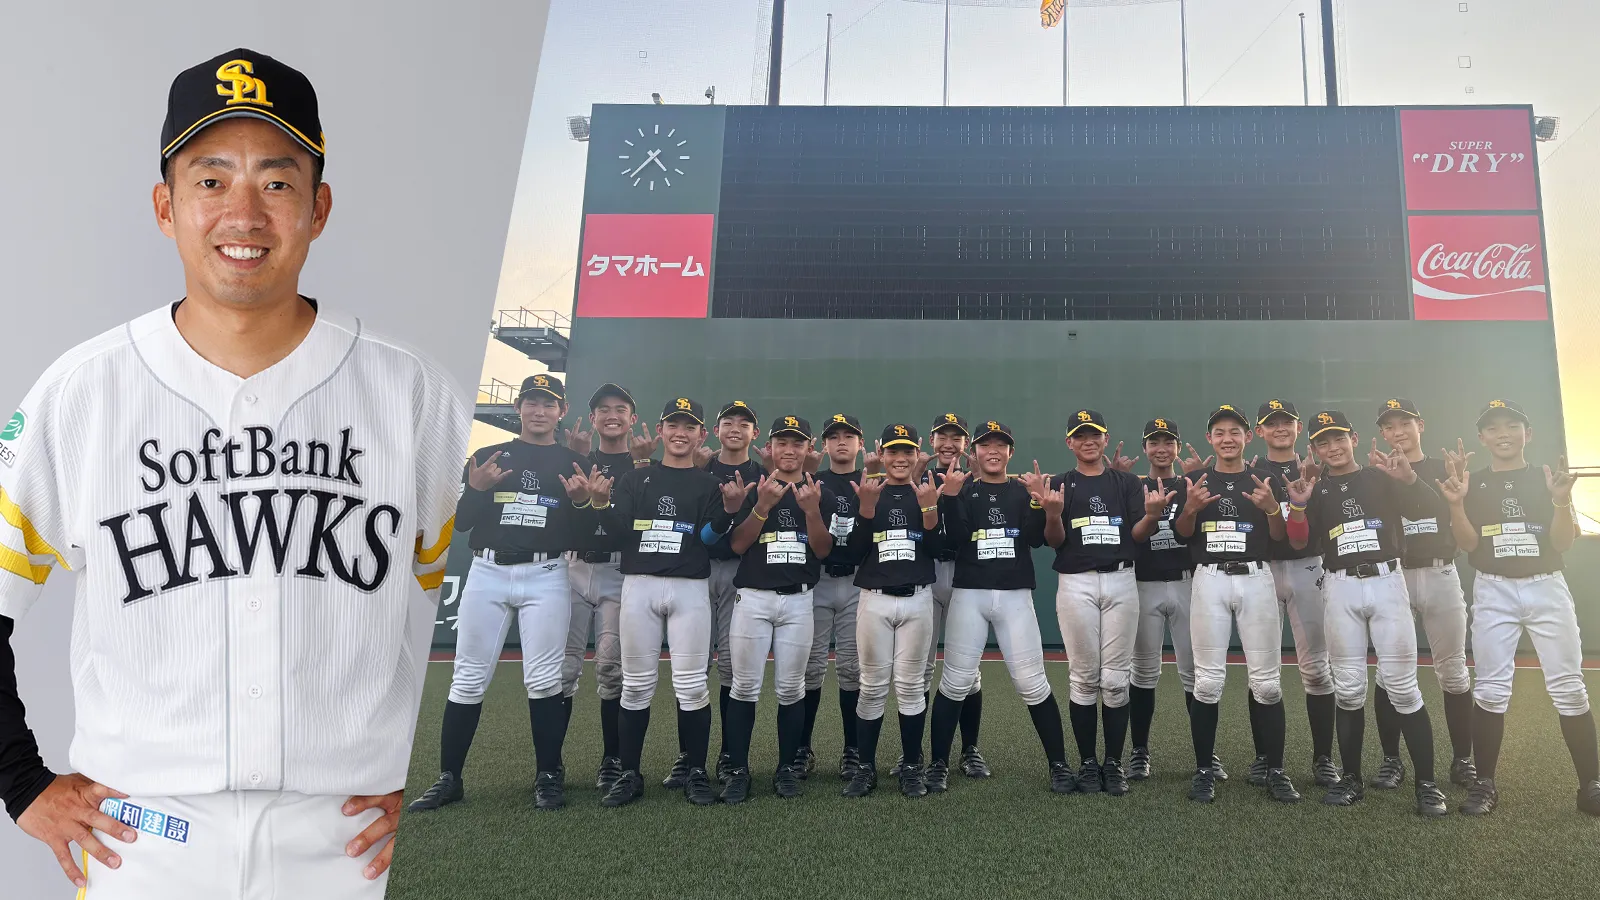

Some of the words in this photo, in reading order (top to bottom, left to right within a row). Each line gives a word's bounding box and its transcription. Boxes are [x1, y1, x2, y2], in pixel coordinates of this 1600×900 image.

[1449, 141, 1493, 150] SUPER
[587, 254, 705, 277] タマホーム
[1417, 243, 1536, 280] Coca-Cola
[139, 425, 363, 492] SoftBank
[99, 490, 401, 604] HAWKS
